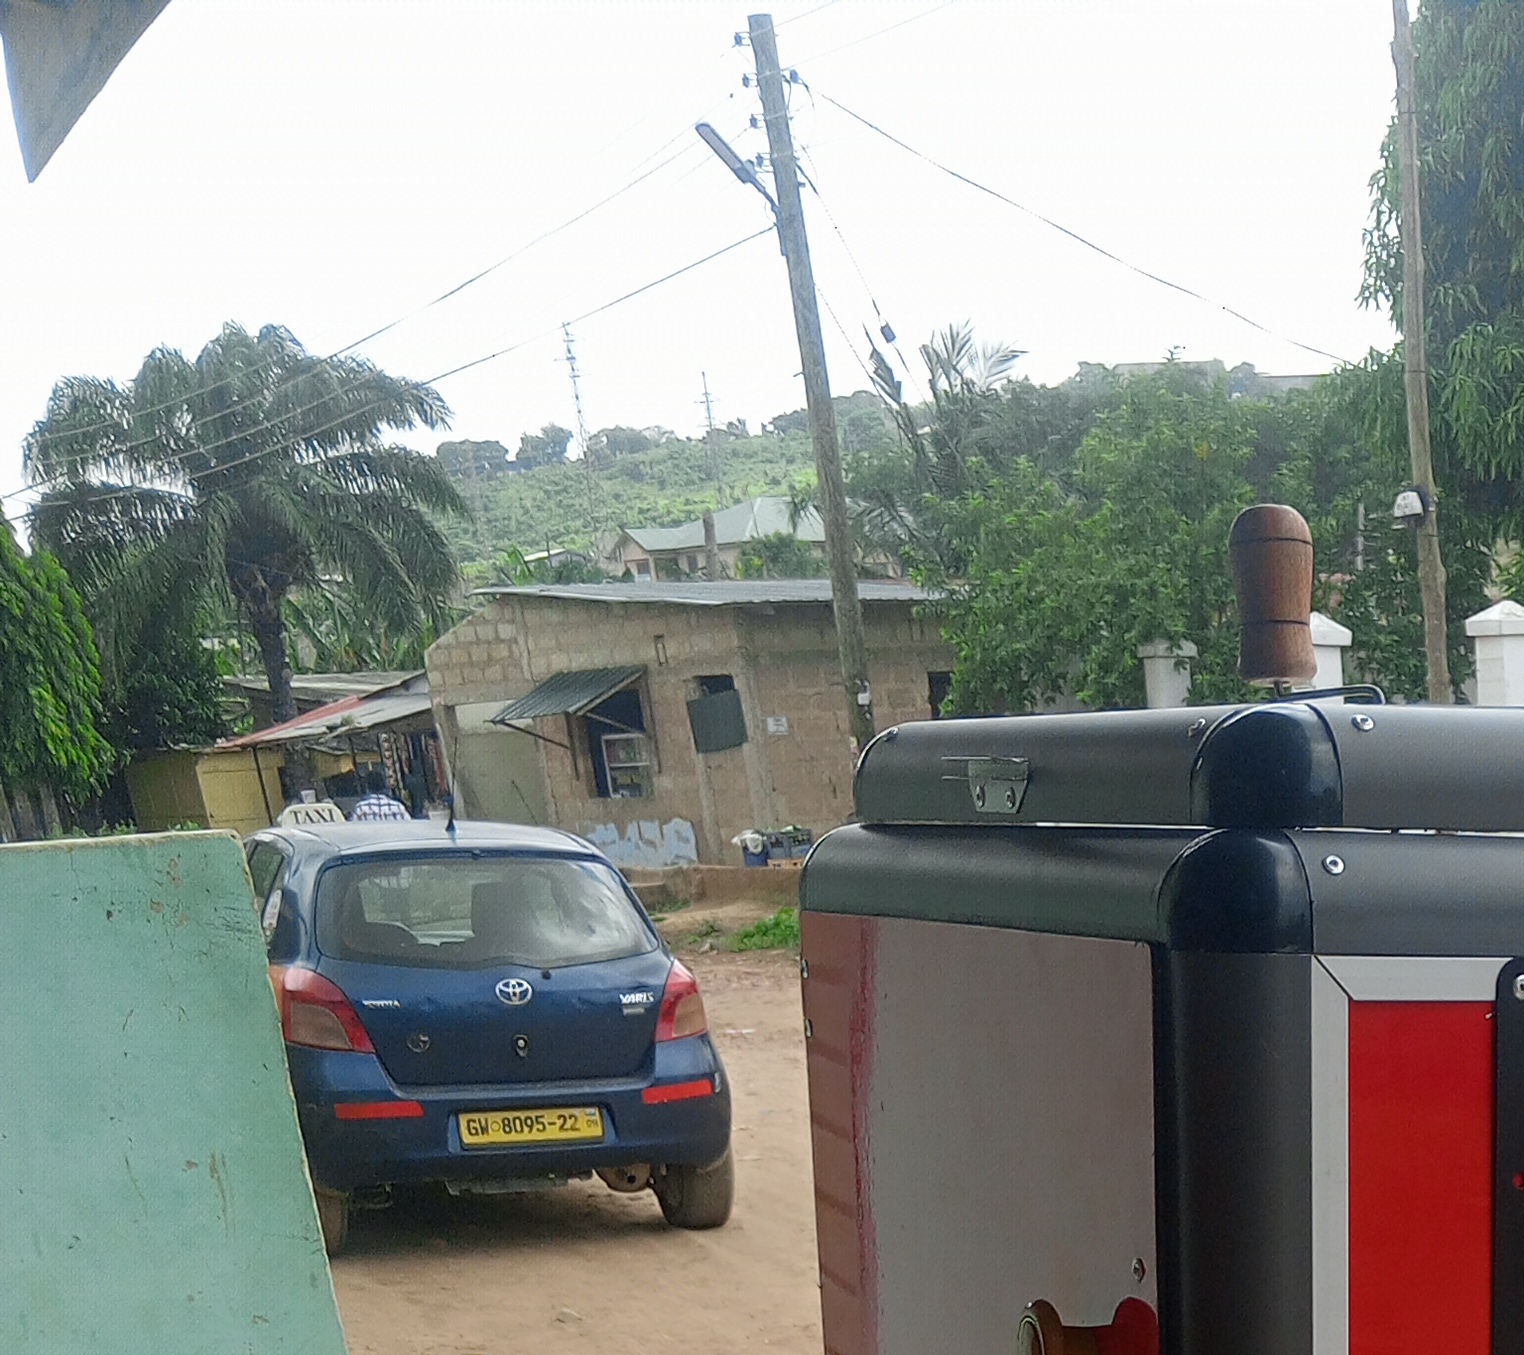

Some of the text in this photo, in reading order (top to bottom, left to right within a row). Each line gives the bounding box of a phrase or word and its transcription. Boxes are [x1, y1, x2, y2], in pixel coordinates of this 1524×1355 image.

[290, 808, 336, 824] TAXI
[466, 1114, 580, 1136] GW 8095-22
